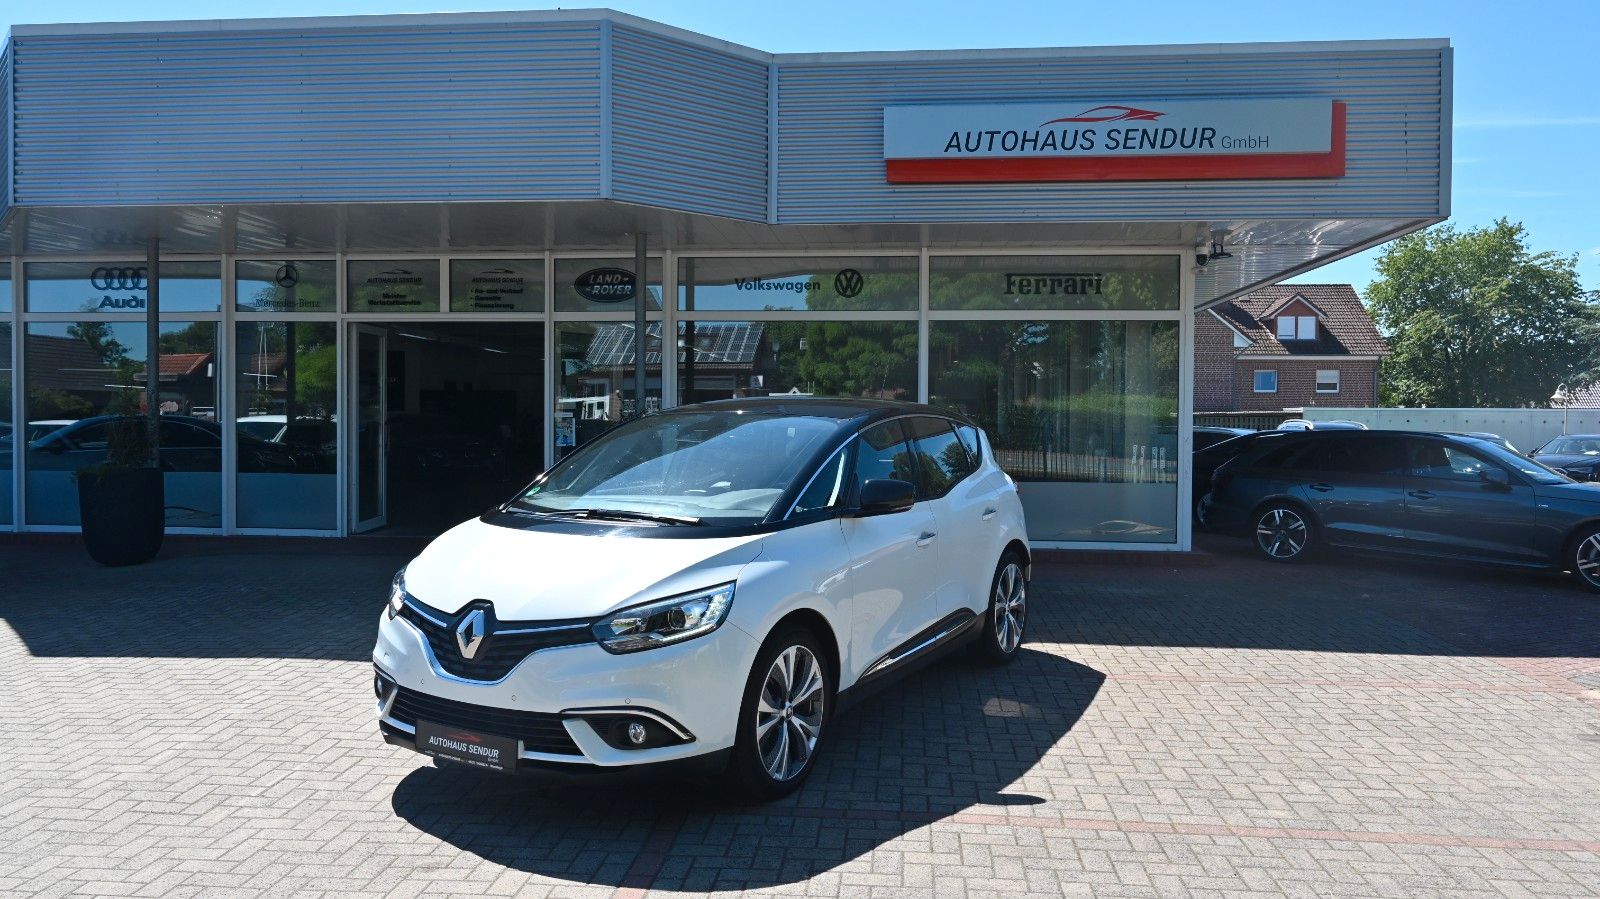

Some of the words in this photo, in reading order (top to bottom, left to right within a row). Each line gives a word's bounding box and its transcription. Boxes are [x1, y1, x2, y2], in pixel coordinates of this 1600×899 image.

[944, 128, 1097, 153] AUTOHAUS
[1104, 127, 1217, 150] SENDUR
[1221, 135, 1269, 149] GmbH
[735, 278, 821, 293] Volkswagen
[1003, 273, 1102, 295] Ferrari
[98, 295, 146, 309] Audi
[428, 736, 467, 752] AUTOHAUS
[468, 744, 500, 758] SENDUR
